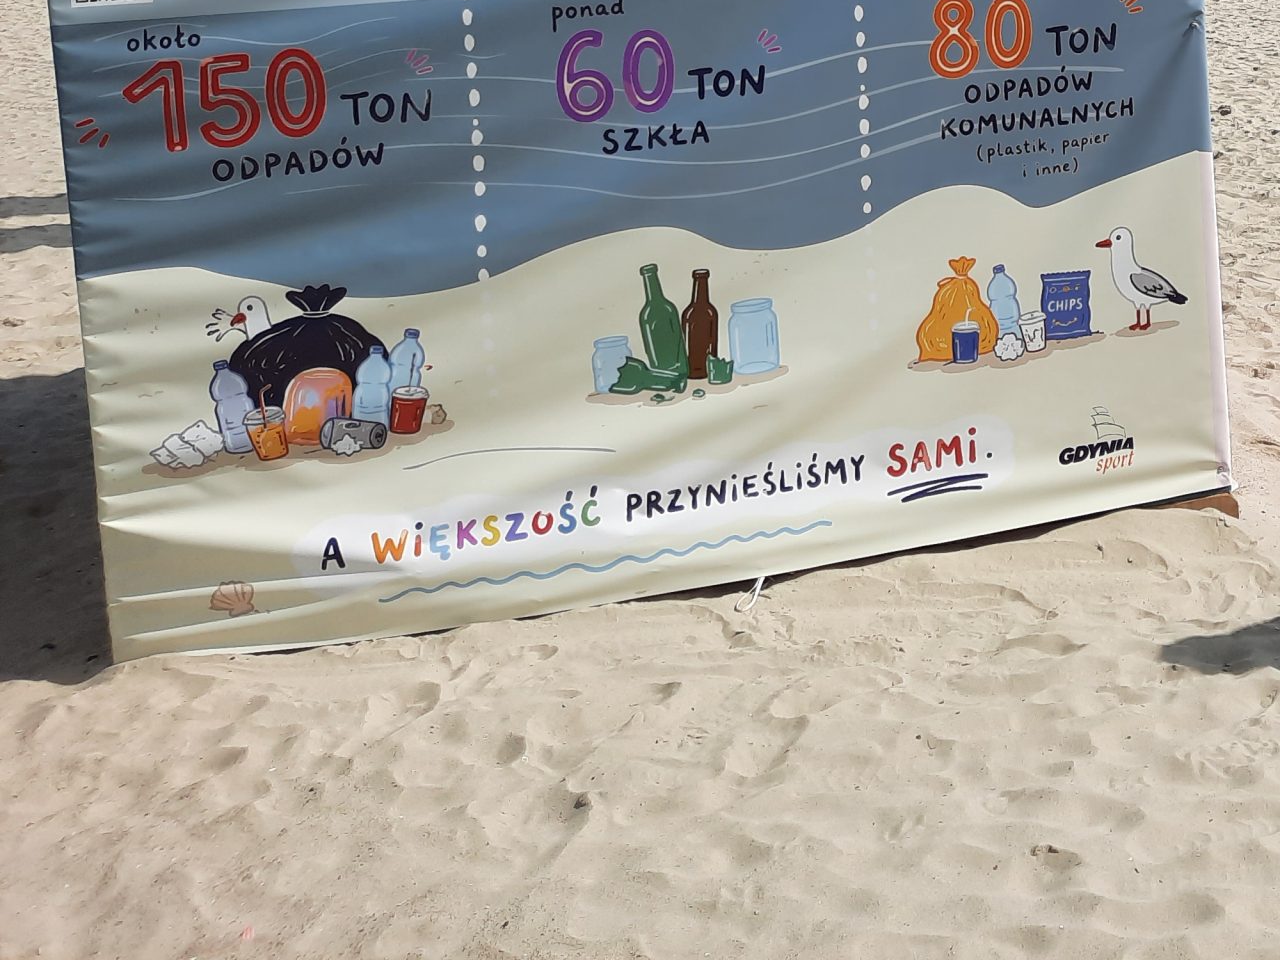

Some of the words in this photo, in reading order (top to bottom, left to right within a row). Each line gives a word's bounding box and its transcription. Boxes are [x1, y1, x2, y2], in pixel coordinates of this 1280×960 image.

[126, 25, 202, 52] około
[1045, 23, 1118, 57] TON
[555, 28, 676, 123] 60
[687, 65, 766, 102] TON
[963, 65, 1095, 105] ODPADÓW
[122, 47, 328, 152] 150
[340, 89, 432, 127] TON
[939, 97, 1136, 141] KOMUNALNYCH
[602, 121, 710, 156] SZKŁA
[976, 141, 1057, 164] (plastik,
[1062, 131, 1110, 159] papier
[212, 136, 385, 182] ODPADÓW
[1022, 164, 1028, 178] i
[1035, 158, 1079, 176] inne)
[1047, 296, 1084, 315] CHIPS
[1058, 437, 1135, 466] GDYNIA
[1095, 449, 1136, 473] sport
[321, 537, 346, 571] A
